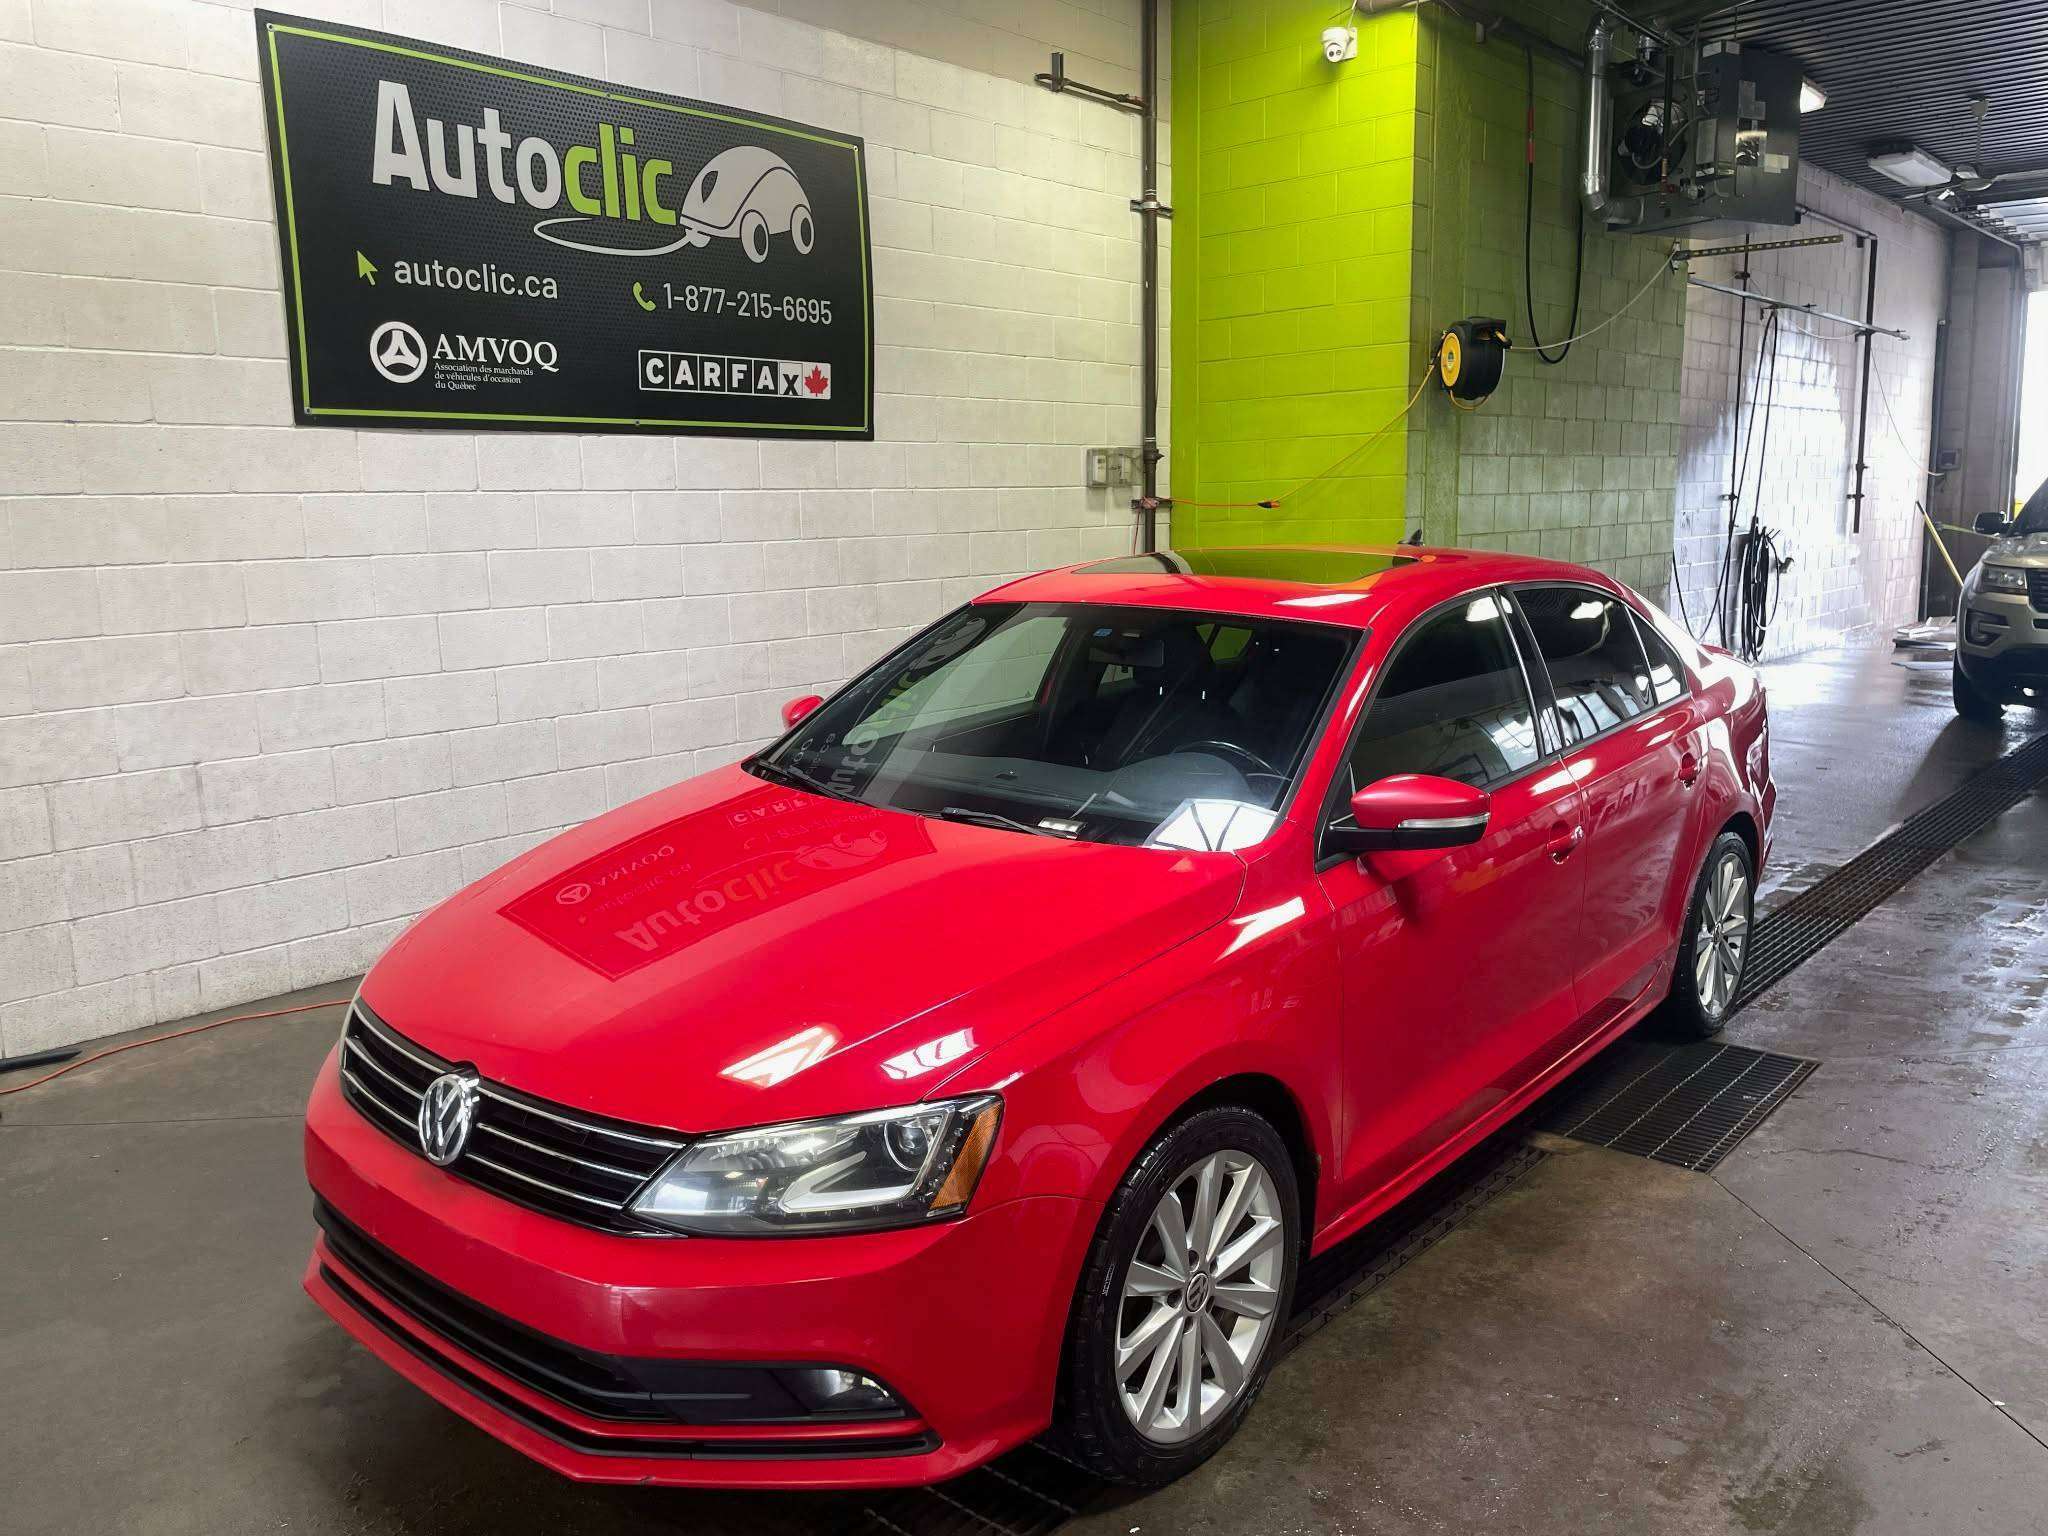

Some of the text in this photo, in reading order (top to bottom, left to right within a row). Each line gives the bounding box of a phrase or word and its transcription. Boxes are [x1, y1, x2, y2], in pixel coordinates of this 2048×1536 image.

[372, 79, 677, 226] Autoclic
[394, 258, 559, 300] autoclic.ca
[663, 282, 833, 326] 1-877-215-6695
[432, 333, 560, 373] AMVOQ
[434, 362, 534, 377] Association des marchands
[434, 372, 522, 385] de véhicules d'occasion
[435, 382, 477, 392] du Québec
[645, 357, 800, 397] CARFAX
